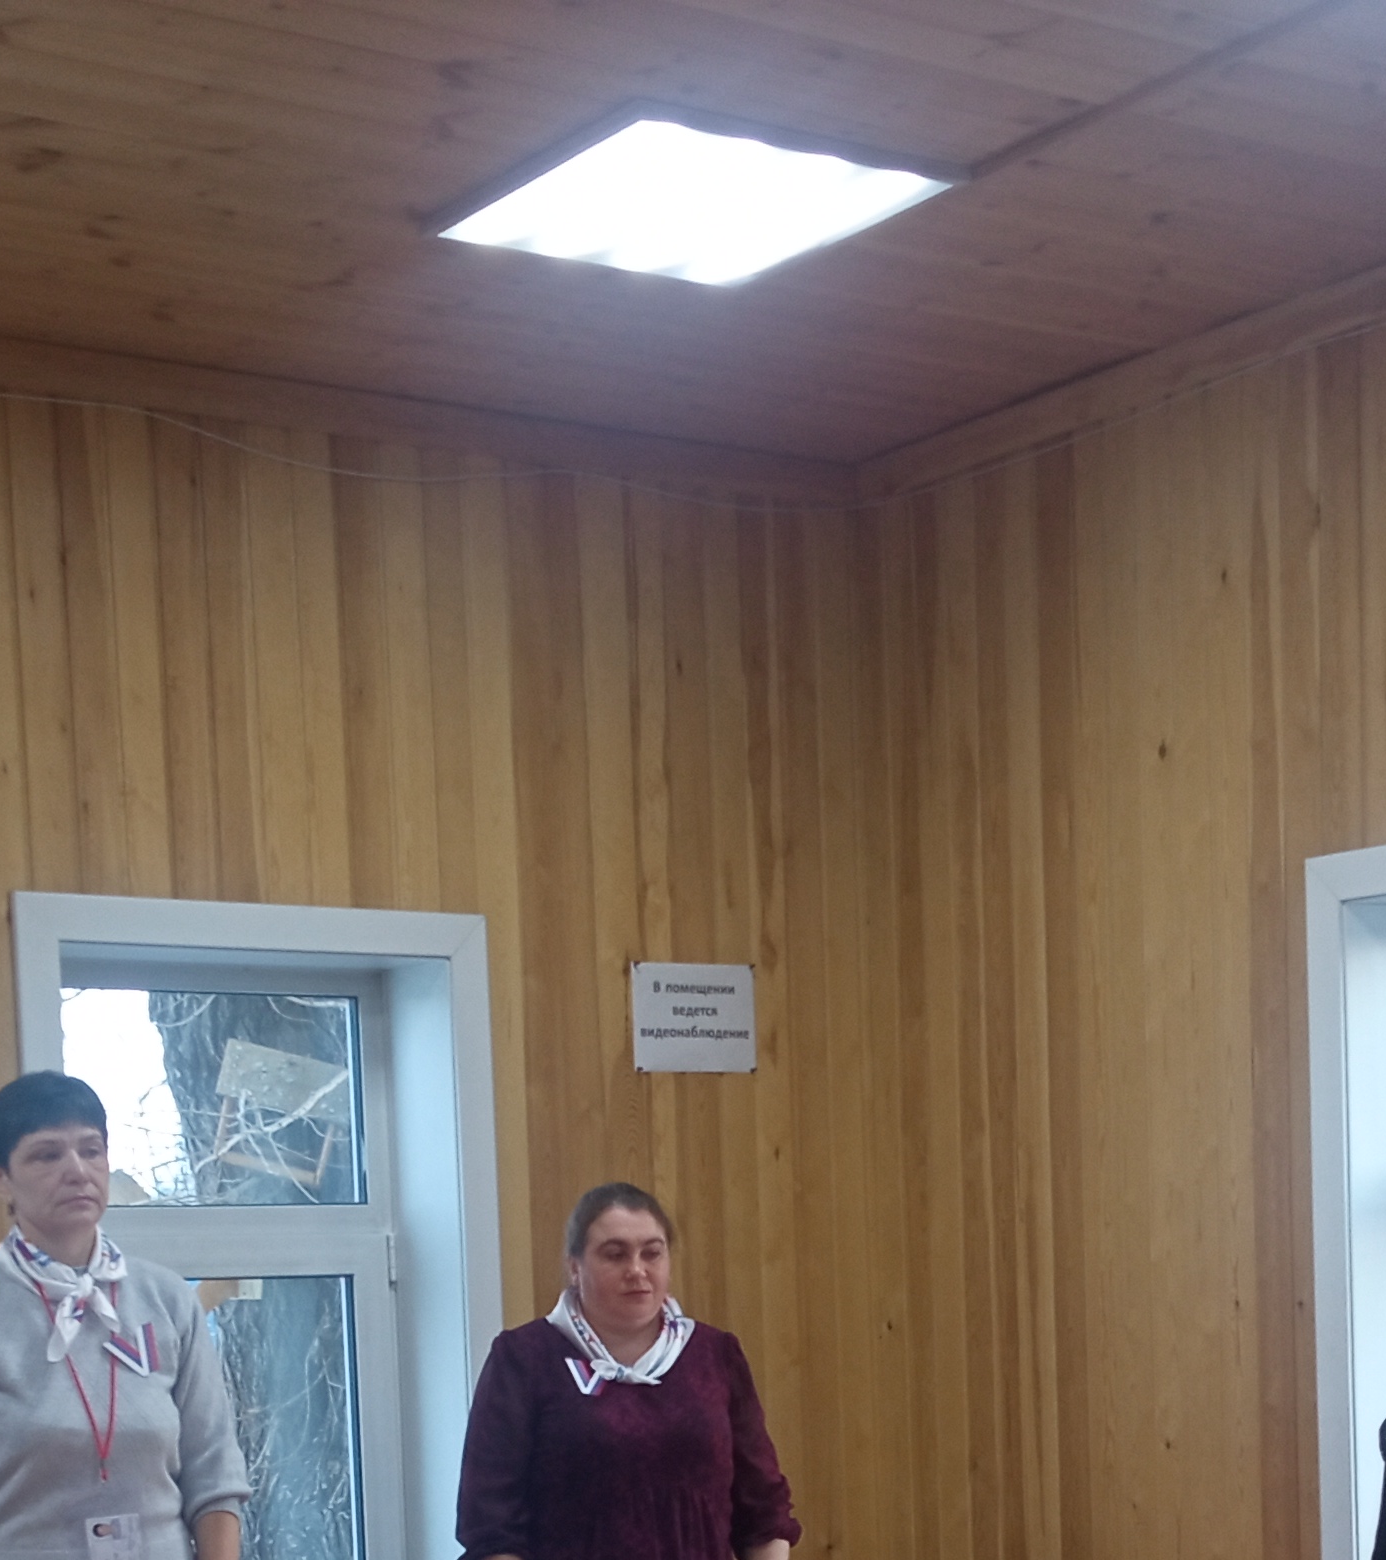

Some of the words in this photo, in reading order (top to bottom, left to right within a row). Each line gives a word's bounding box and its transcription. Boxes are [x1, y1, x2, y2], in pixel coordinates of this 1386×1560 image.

[653, 981, 661, 993] В
[665, 983, 735, 995] помещении
[672, 1006, 718, 1018] ведется
[640, 1026, 750, 1040] видеонаблюдение
